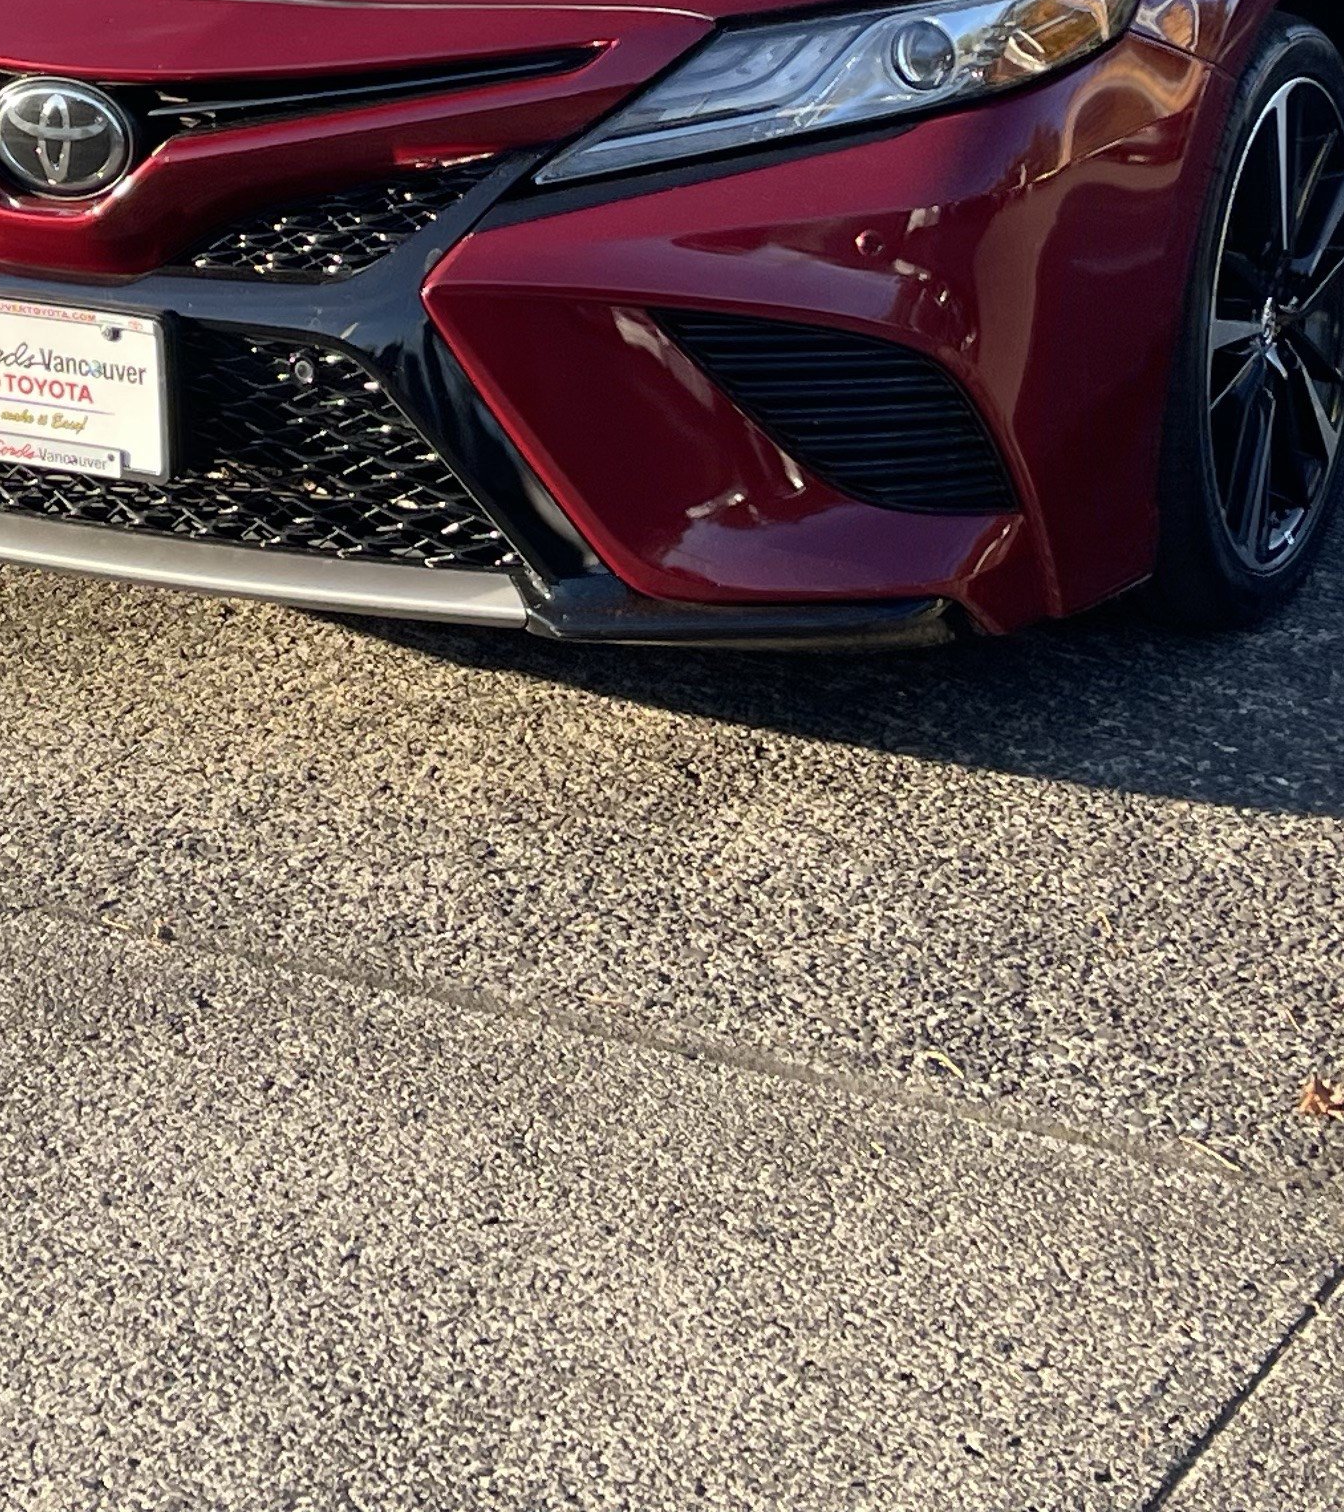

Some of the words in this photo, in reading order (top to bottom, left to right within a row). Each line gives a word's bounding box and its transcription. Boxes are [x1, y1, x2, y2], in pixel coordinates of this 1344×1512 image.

[39, 348, 146, 385] Vancouver
[4, 373, 94, 404] TOYOTA
[38, 446, 107, 470] Vancouver
